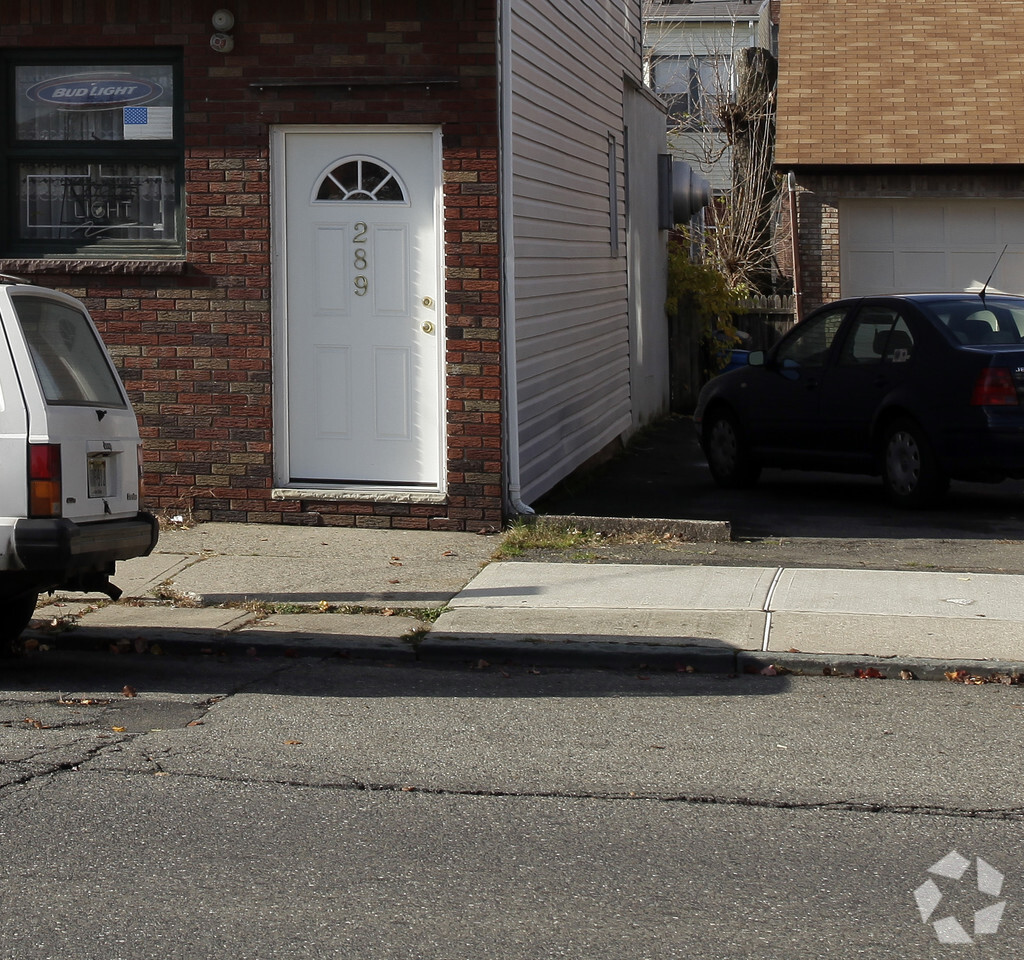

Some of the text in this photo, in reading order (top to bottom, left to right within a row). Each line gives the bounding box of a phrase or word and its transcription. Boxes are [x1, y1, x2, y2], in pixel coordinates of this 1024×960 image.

[52, 85, 138, 98] BUD LIGHT
[352, 220, 369, 297] 289
